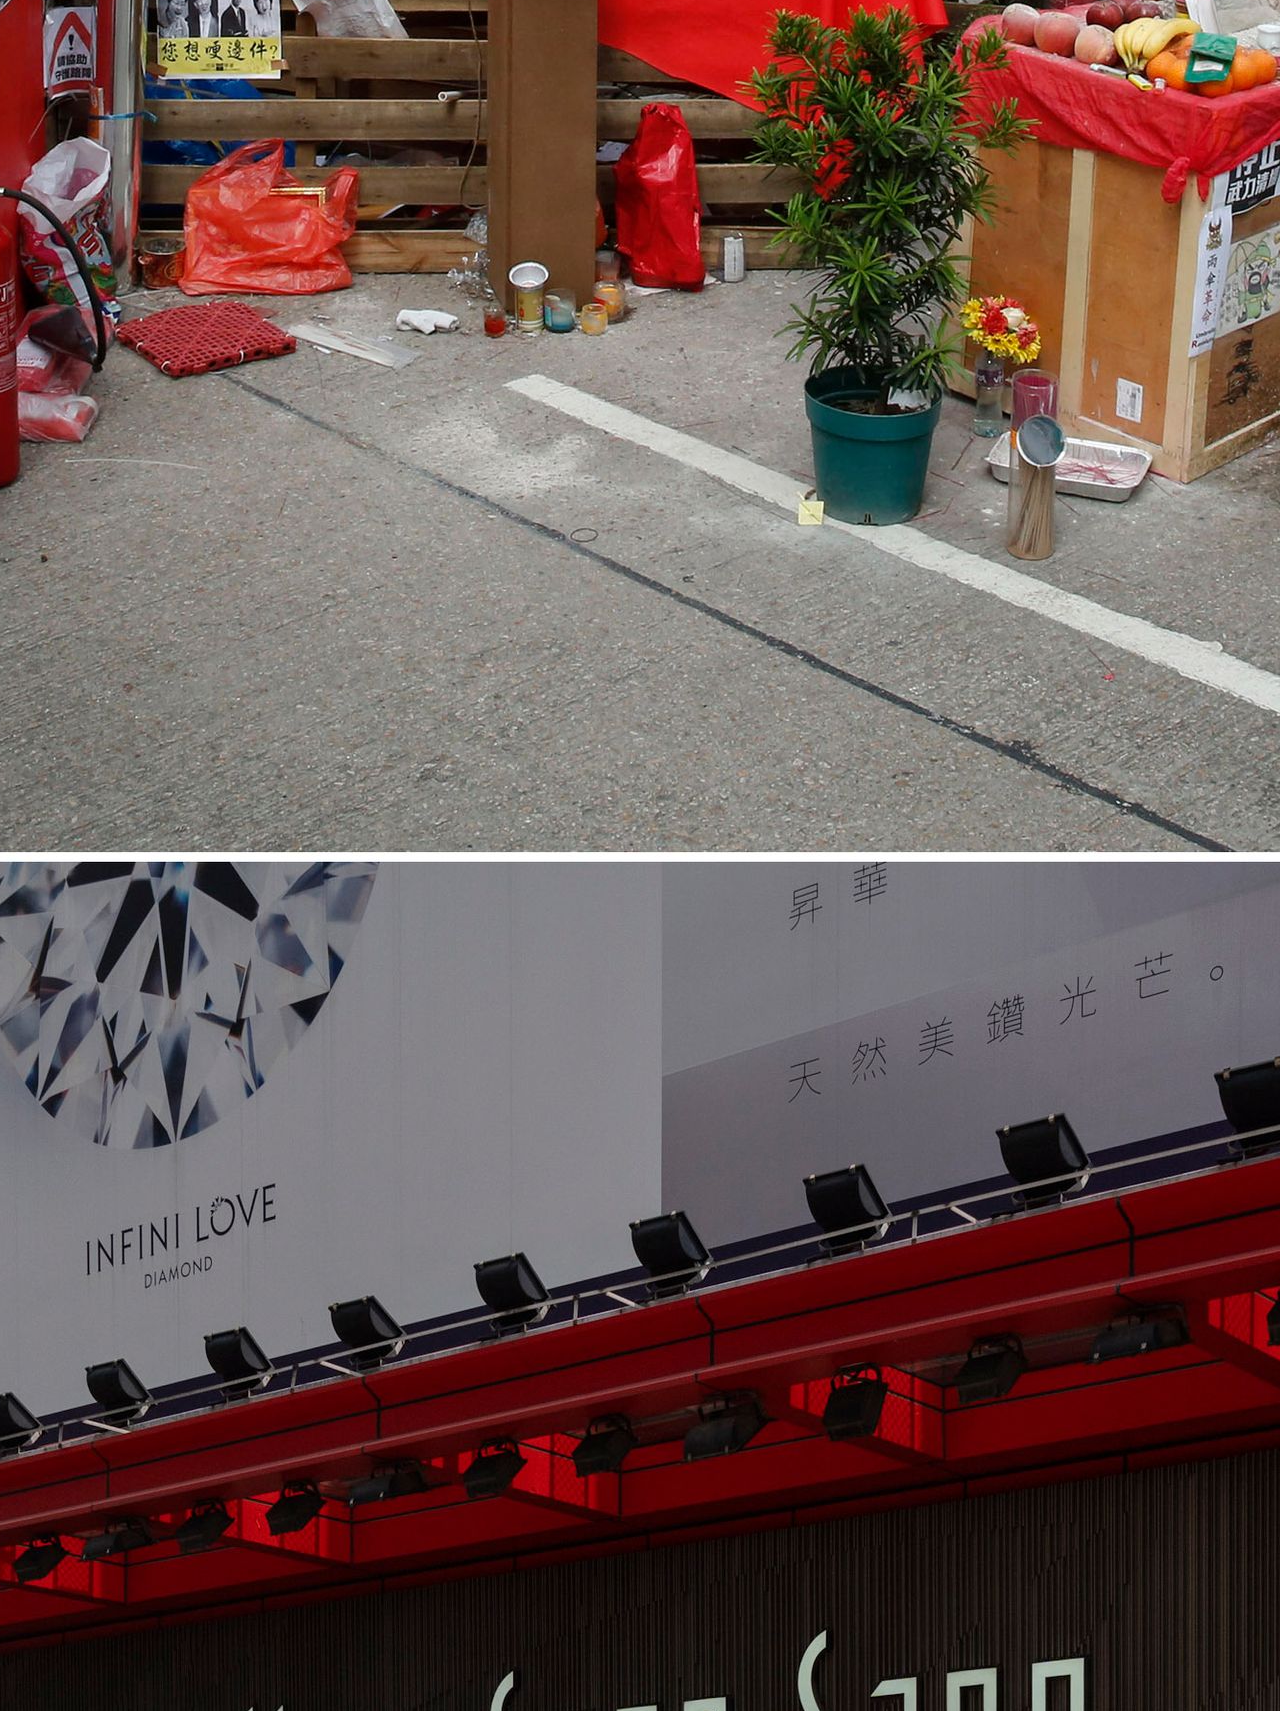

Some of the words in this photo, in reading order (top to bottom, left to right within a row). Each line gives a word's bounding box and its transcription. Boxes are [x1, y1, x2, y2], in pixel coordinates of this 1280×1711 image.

[87, 1213, 180, 1276] INFINI
[196, 1183, 277, 1243] LOVE
[144, 1256, 213, 1289] DIAMOND
